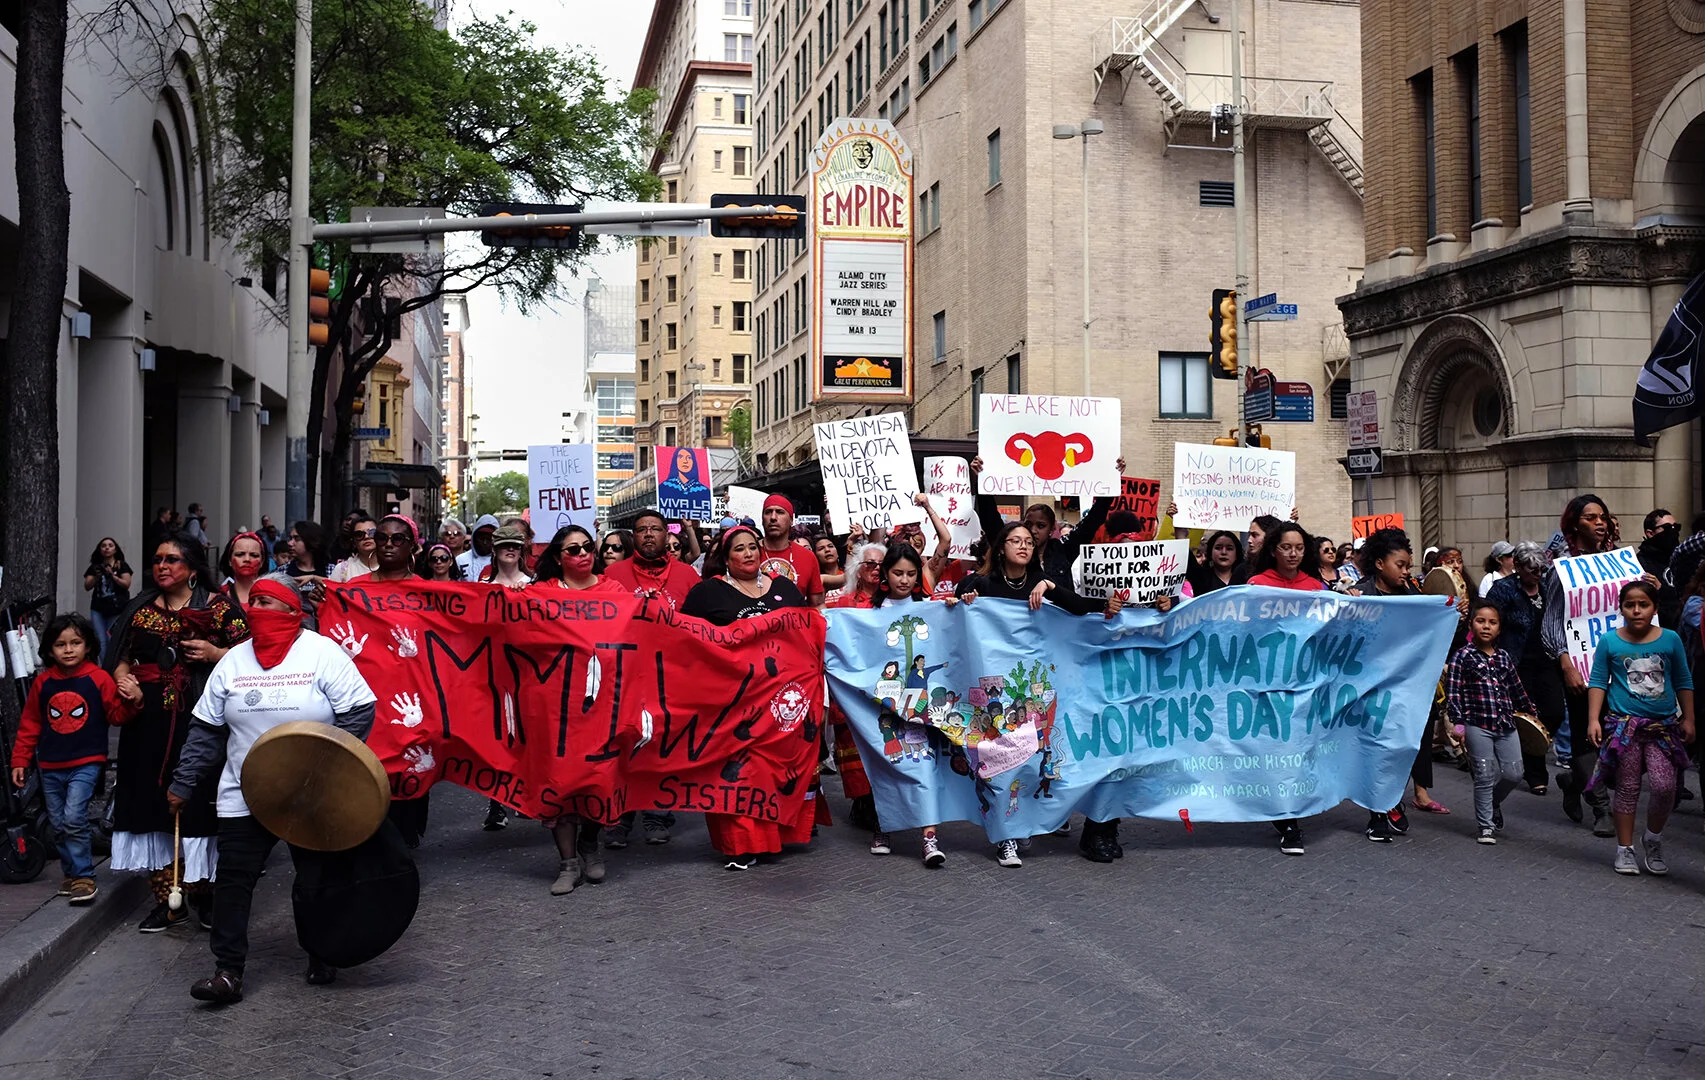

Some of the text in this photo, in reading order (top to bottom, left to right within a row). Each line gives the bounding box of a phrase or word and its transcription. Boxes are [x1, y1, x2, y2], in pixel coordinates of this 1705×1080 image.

[823, 184, 904, 228] EMPIRE
[838, 271, 886, 280] ALAMO CITY
[839, 281, 858, 289] JAZZ
[830, 298, 897, 308] WARREN HILL AND
[836, 307, 893, 317] CINDY BRADLEY
[848, 326, 877, 335] MAR 13
[852, 378, 892, 387] PERFORMANCES
[990, 394, 1102, 417] WE ARE NOT
[818, 416, 903, 441] NI SUMISA
[550, 445, 570, 457] THE
[820, 437, 900, 460] NI DEVOTA
[540, 457, 583, 475] FUTURE
[823, 459, 877, 479] MUJER
[1187, 451, 1281, 477] NO MORE
[1351, 455, 1373, 466] ONE WAY
[554, 475, 570, 487] IS
[843, 474, 897, 495] LIBRE
[982, 475, 1111, 496] OVERY-ACTING
[1181, 472, 1223, 486] MISSING
[538, 487, 592, 511] FEMALE
[660, 497, 711, 510] VIVA LA
[846, 490, 915, 514] LINDA Y
[660, 508, 711, 521] MUJER
[1222, 504, 1280, 518] #MMIWG
[1353, 514, 1394, 540] STOP
[1083, 542, 1165, 560] IF YOU DON'T
[1083, 553, 1179, 576] FIGHT FOR ALL
[1559, 549, 1641, 589] TRANS
[1136, 576, 1160, 589] YOU
[1163, 573, 1187, 587] FIGHT
[1084, 588, 1107, 598] FOR
[1113, 588, 1131, 602] NO
[1568, 576, 1645, 619] WOM
[335, 587, 467, 617] MISSING
[484, 589, 618, 623] MURDERED
[1171, 600, 1251, 636] ANNUAL
[1260, 599, 1301, 619] SAN
[1306, 598, 1384, 622] ANTONIO
[1099, 630, 1366, 701] INTERNATIONAL
[232, 675, 271, 683] INDIGENOUS
[1063, 692, 1216, 762] WOMEN'S
[1226, 690, 1295, 742] DAY
[1234, 755, 1261, 770] OUR
[440, 756, 525, 808] MORE
[653, 775, 779, 821] SISTERS
[1223, 784, 1271, 797] MARCH
